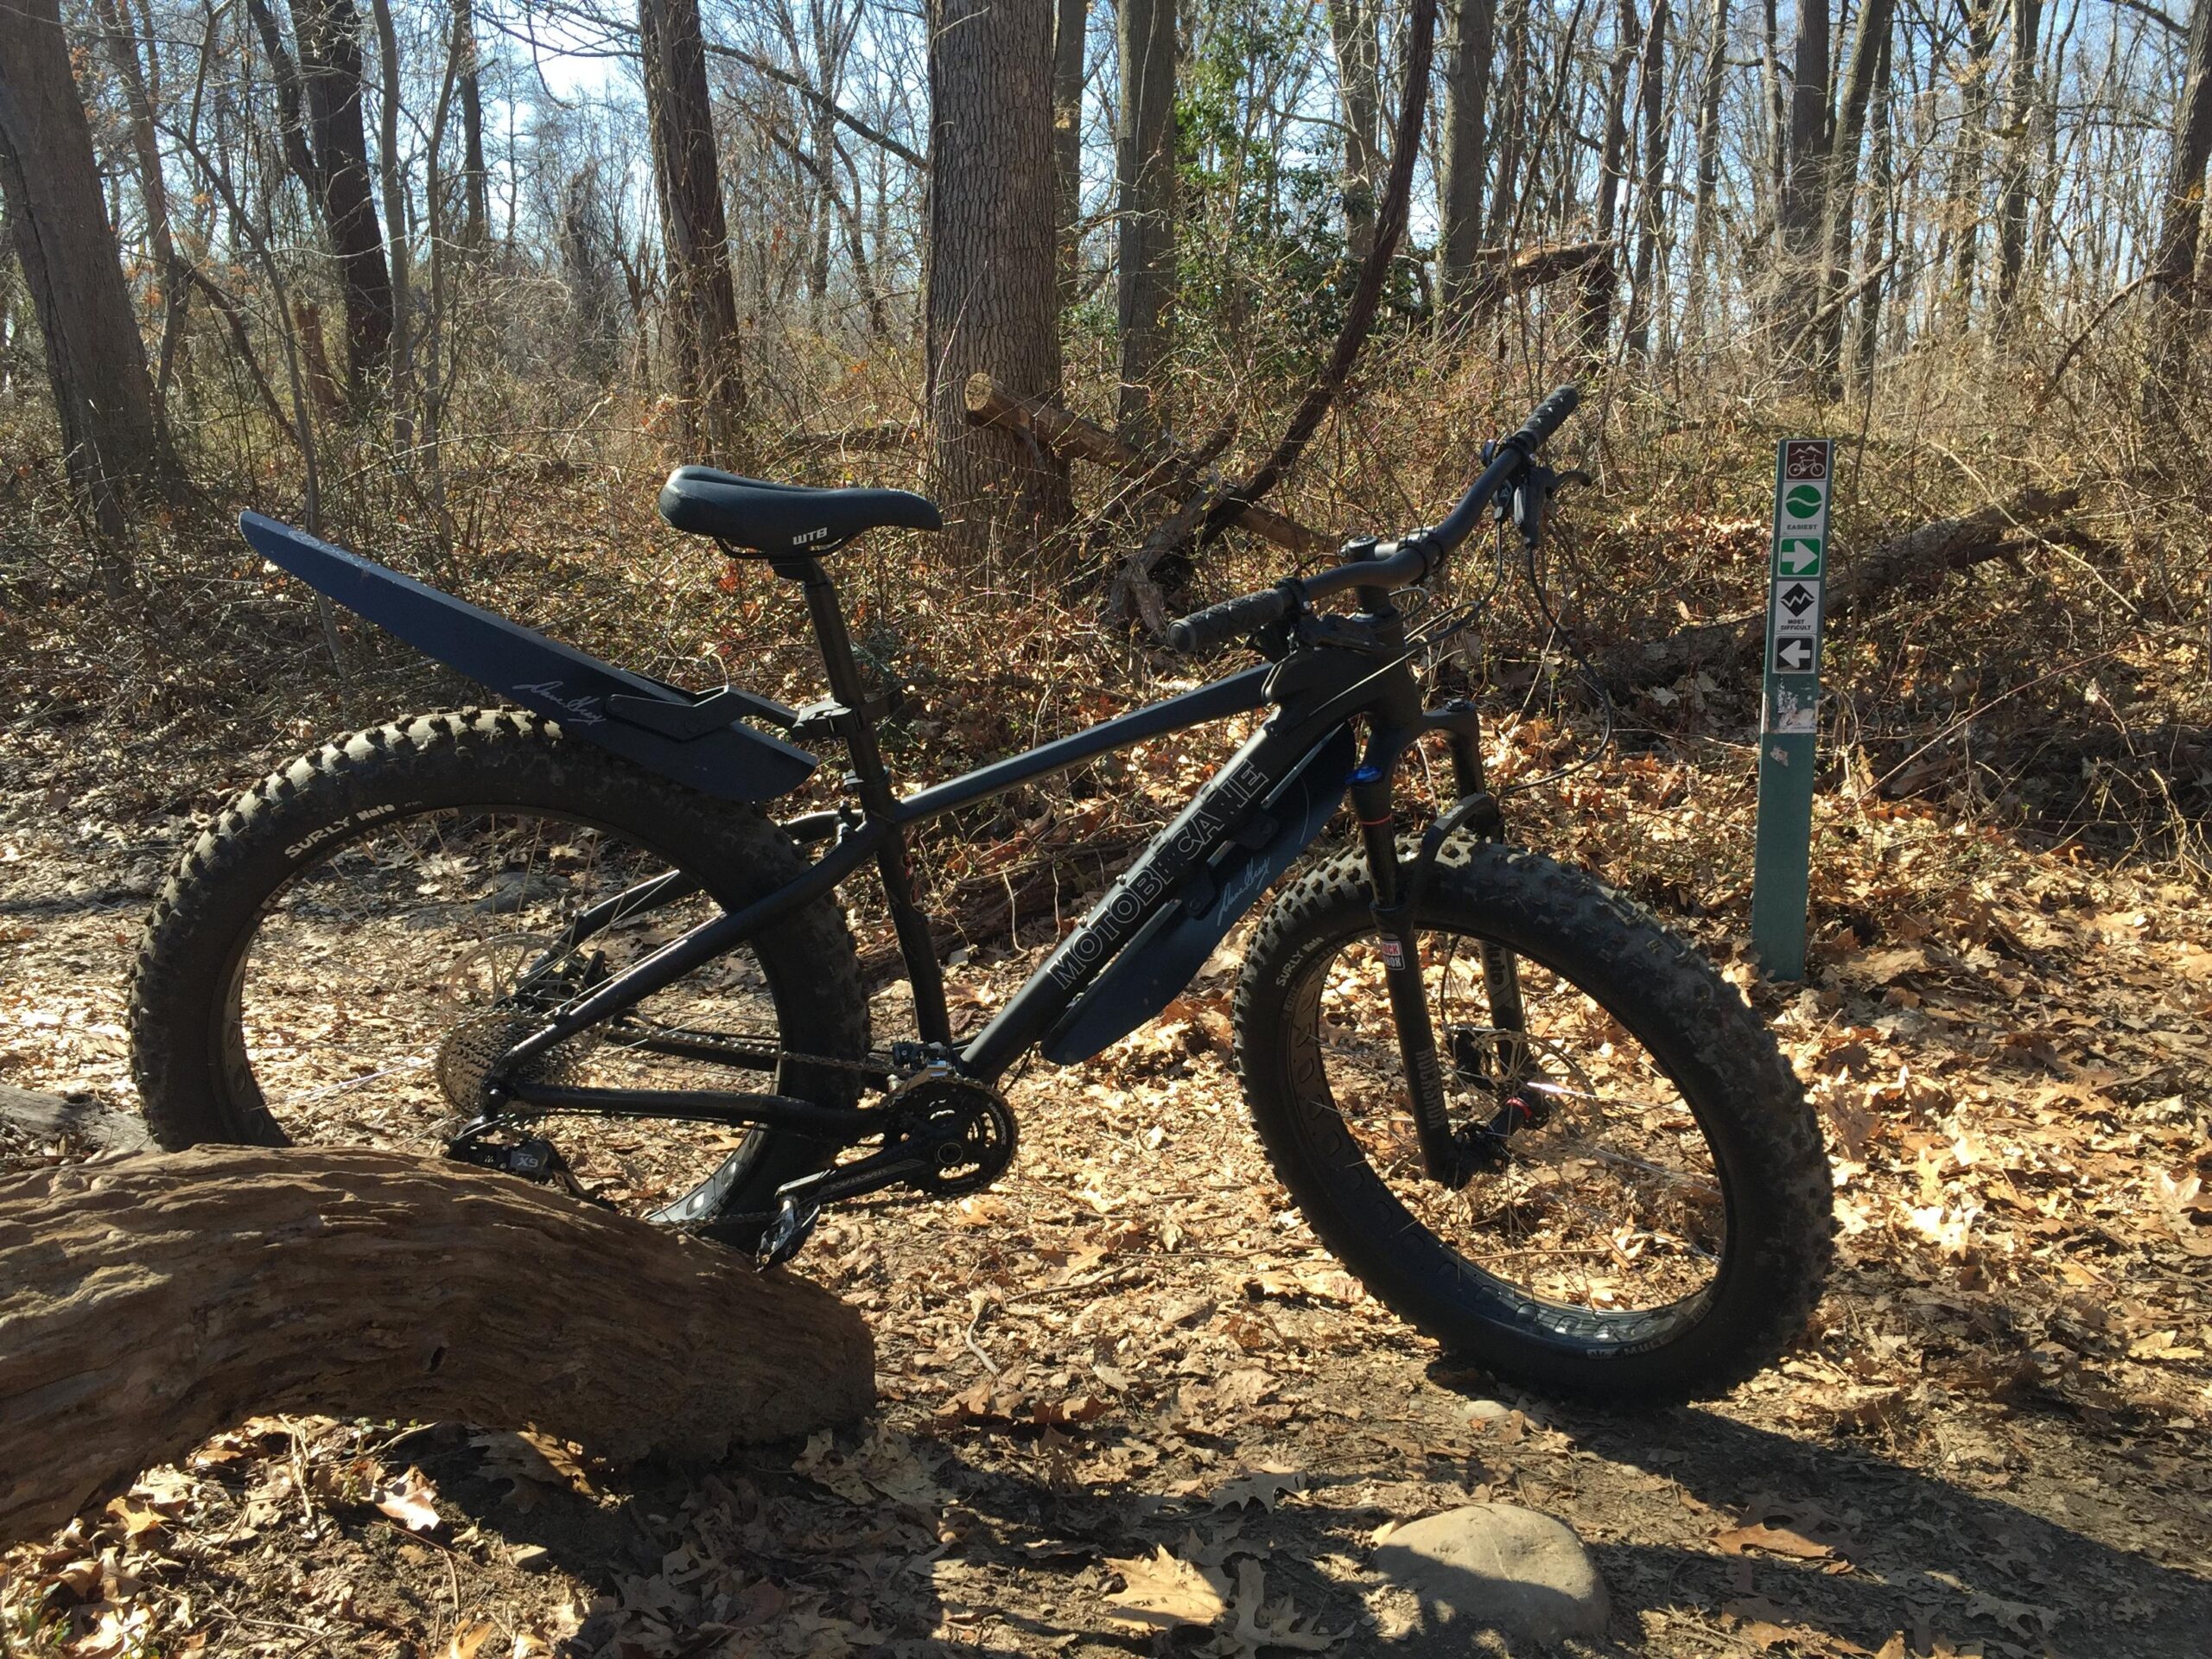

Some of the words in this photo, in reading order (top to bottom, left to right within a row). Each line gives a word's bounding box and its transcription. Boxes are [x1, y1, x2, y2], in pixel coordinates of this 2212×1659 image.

[792, 527, 828, 546] WTB
[284, 817, 350, 859] SURLY
[1382, 944, 1399, 955] OCK
[1275, 950, 1304, 987] SURLY
